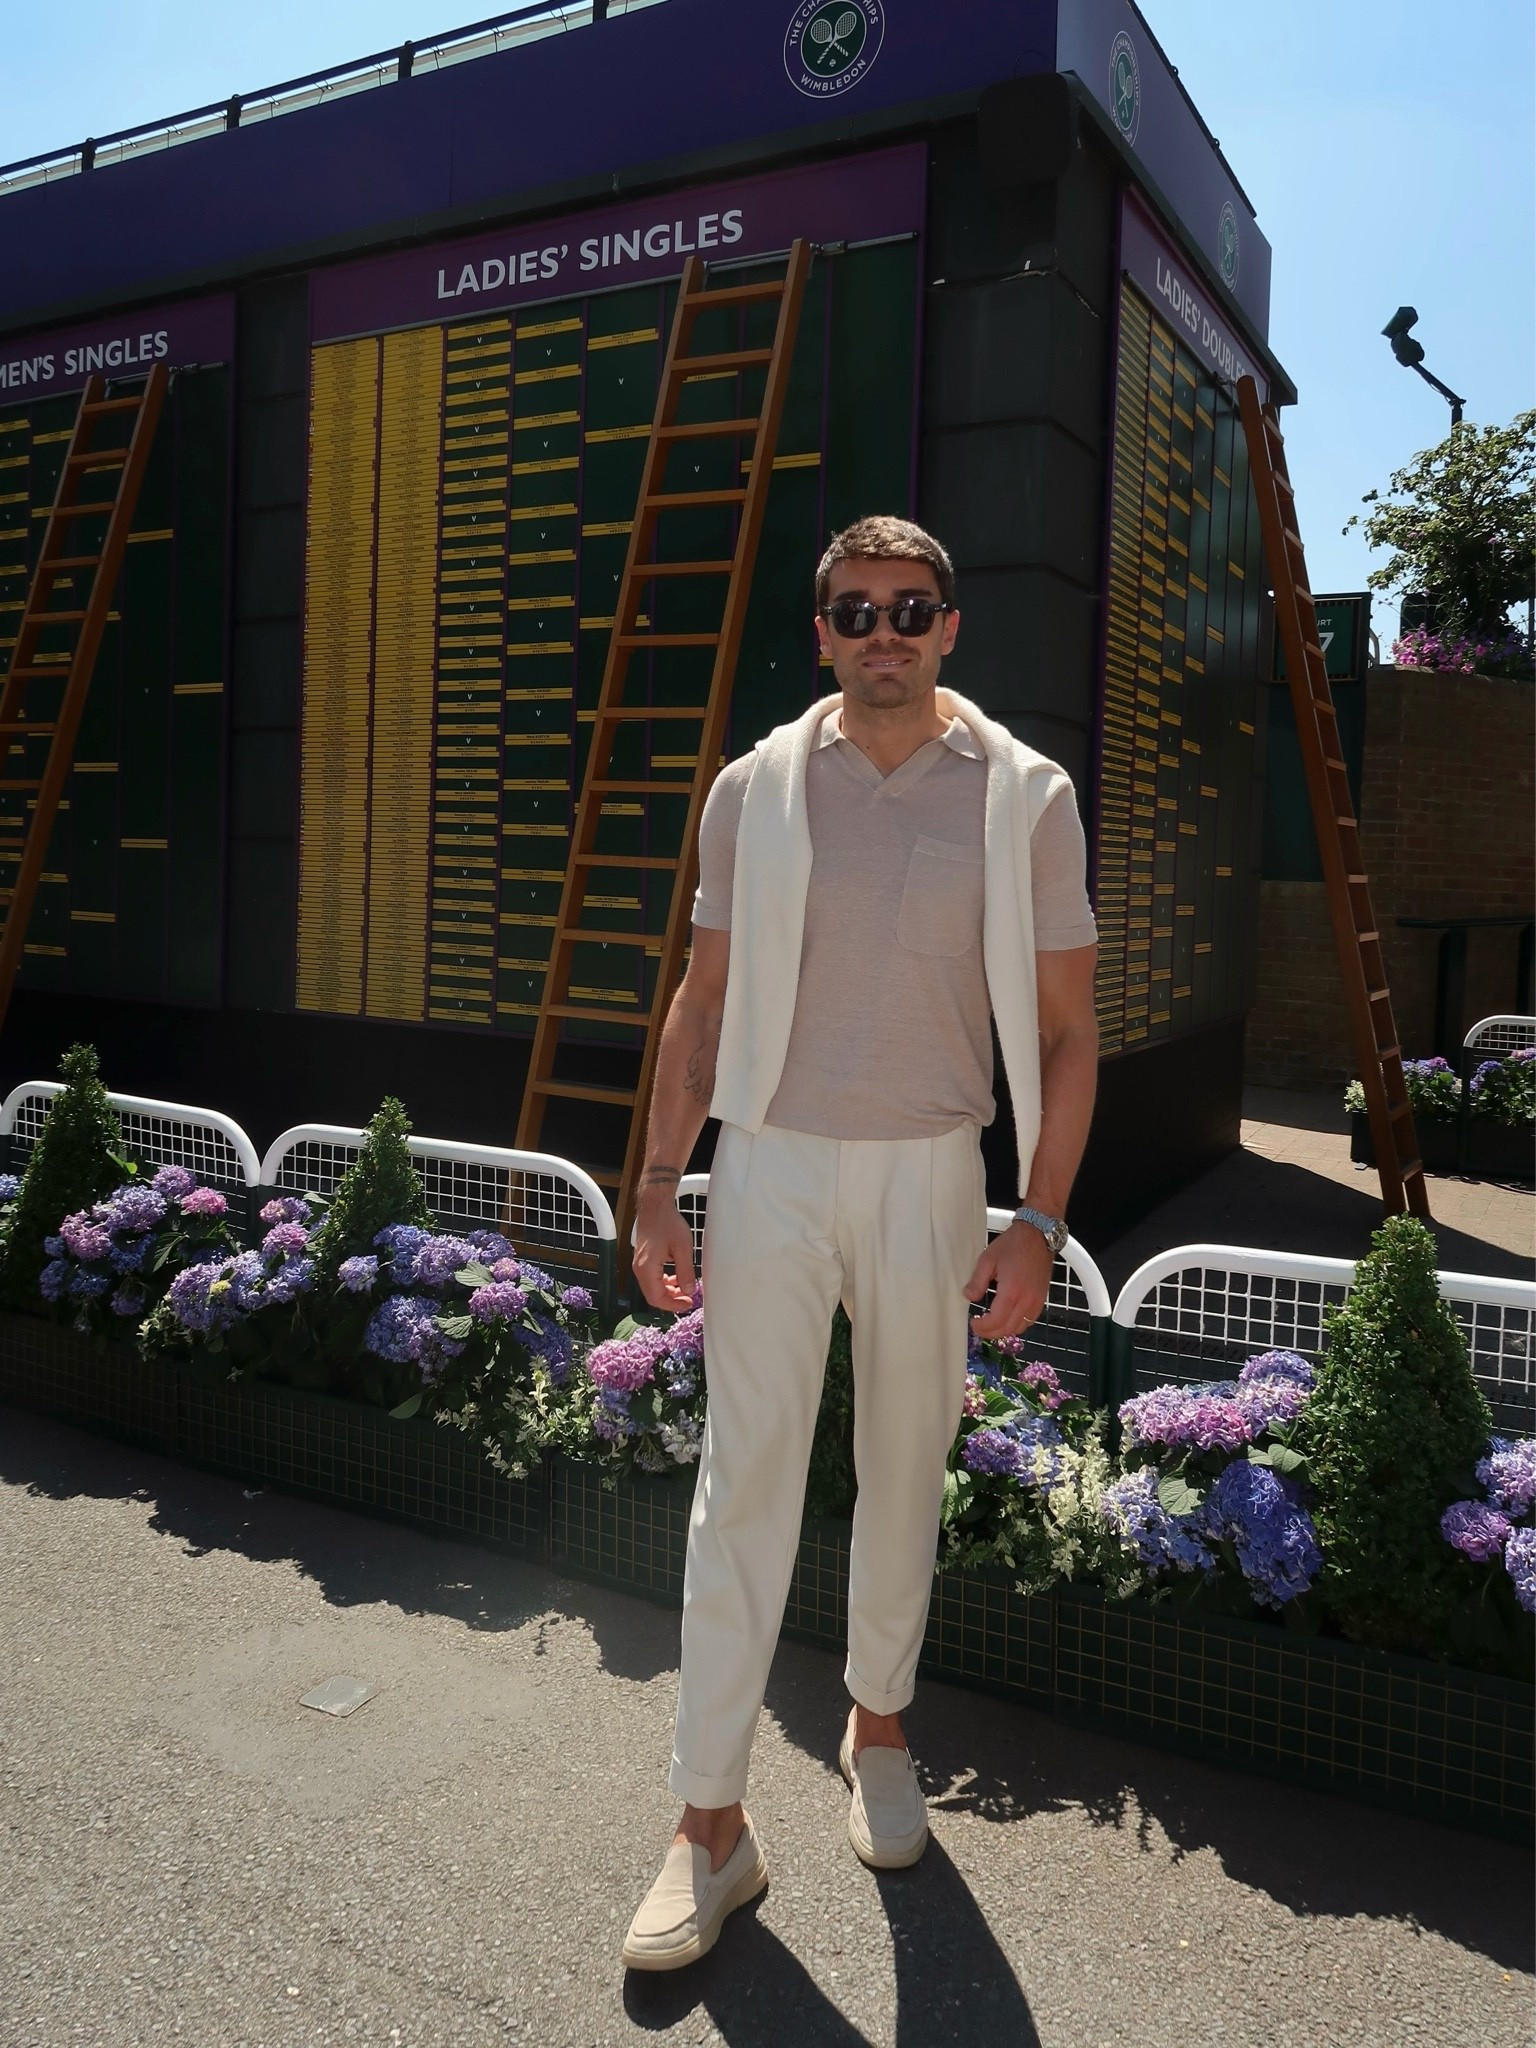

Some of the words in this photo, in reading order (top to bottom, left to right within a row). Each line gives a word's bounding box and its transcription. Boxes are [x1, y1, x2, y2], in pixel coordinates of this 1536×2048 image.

[789, 20, 804, 46] THE
[800, 59, 867, 91] WIMBLEDON
[437, 244, 569, 299] LADIES'
[579, 209, 743, 271] SINGLES
[1156, 257, 1201, 333] LADIES'
[64, 331, 169, 375] SINGLES
